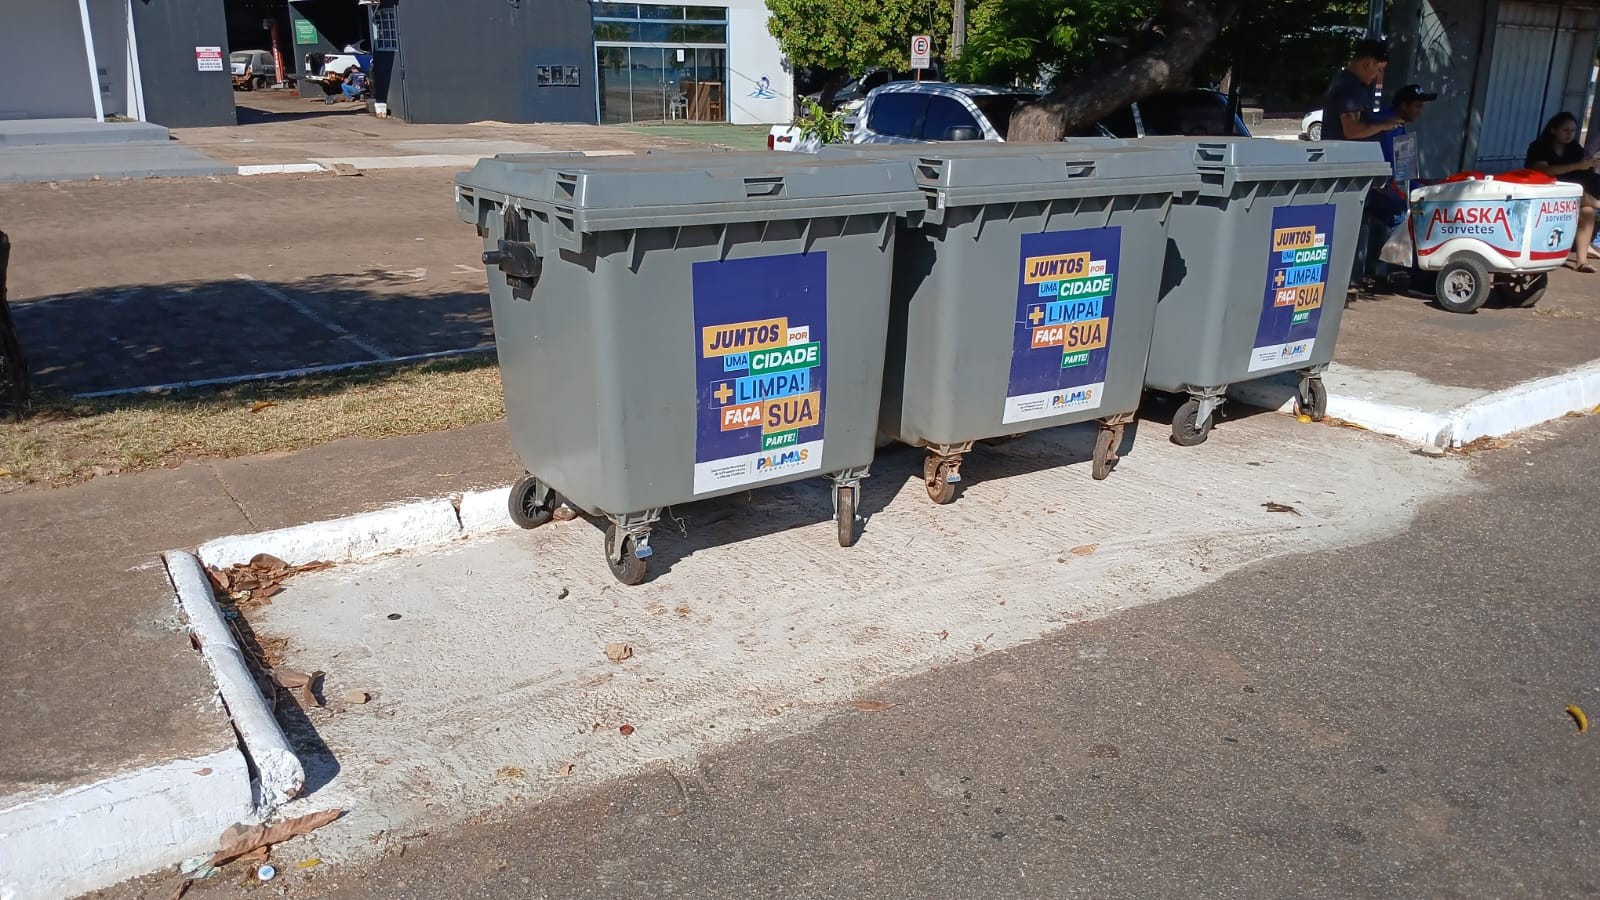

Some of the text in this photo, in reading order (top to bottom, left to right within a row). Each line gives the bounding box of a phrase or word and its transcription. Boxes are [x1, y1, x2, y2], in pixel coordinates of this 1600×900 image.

[918, 41, 924, 51] E
[1426, 207, 1513, 241] ALASKA
[1545, 214, 1572, 223] sorvetes
[1277, 230, 1311, 246] JUNTOS
[1441, 224, 1494, 235] sorvetes
[1296, 249, 1328, 263] CIDADE
[1030, 257, 1104, 278] JUNTOS POR
[1287, 267, 1319, 285] LIMPA!
[1040, 278, 1111, 296] UMA CIDADE
[1277, 288, 1319, 306] FAÇA SUA
[1049, 301, 1099, 321] LIMPA!
[709, 324, 808, 350] JUNTOS POR
[1035, 323, 1101, 348] FAÇA SUA
[726, 346, 818, 370] UMA CIDADE
[1064, 353, 1088, 365] PARTE!
[740, 373, 805, 401] LIMPA!
[1052, 390, 1092, 406] PALMAS
[724, 398, 813, 427] FAÇA SUA
[766, 433, 796, 447] PARTE!
[757, 449, 809, 470] PALMAS
